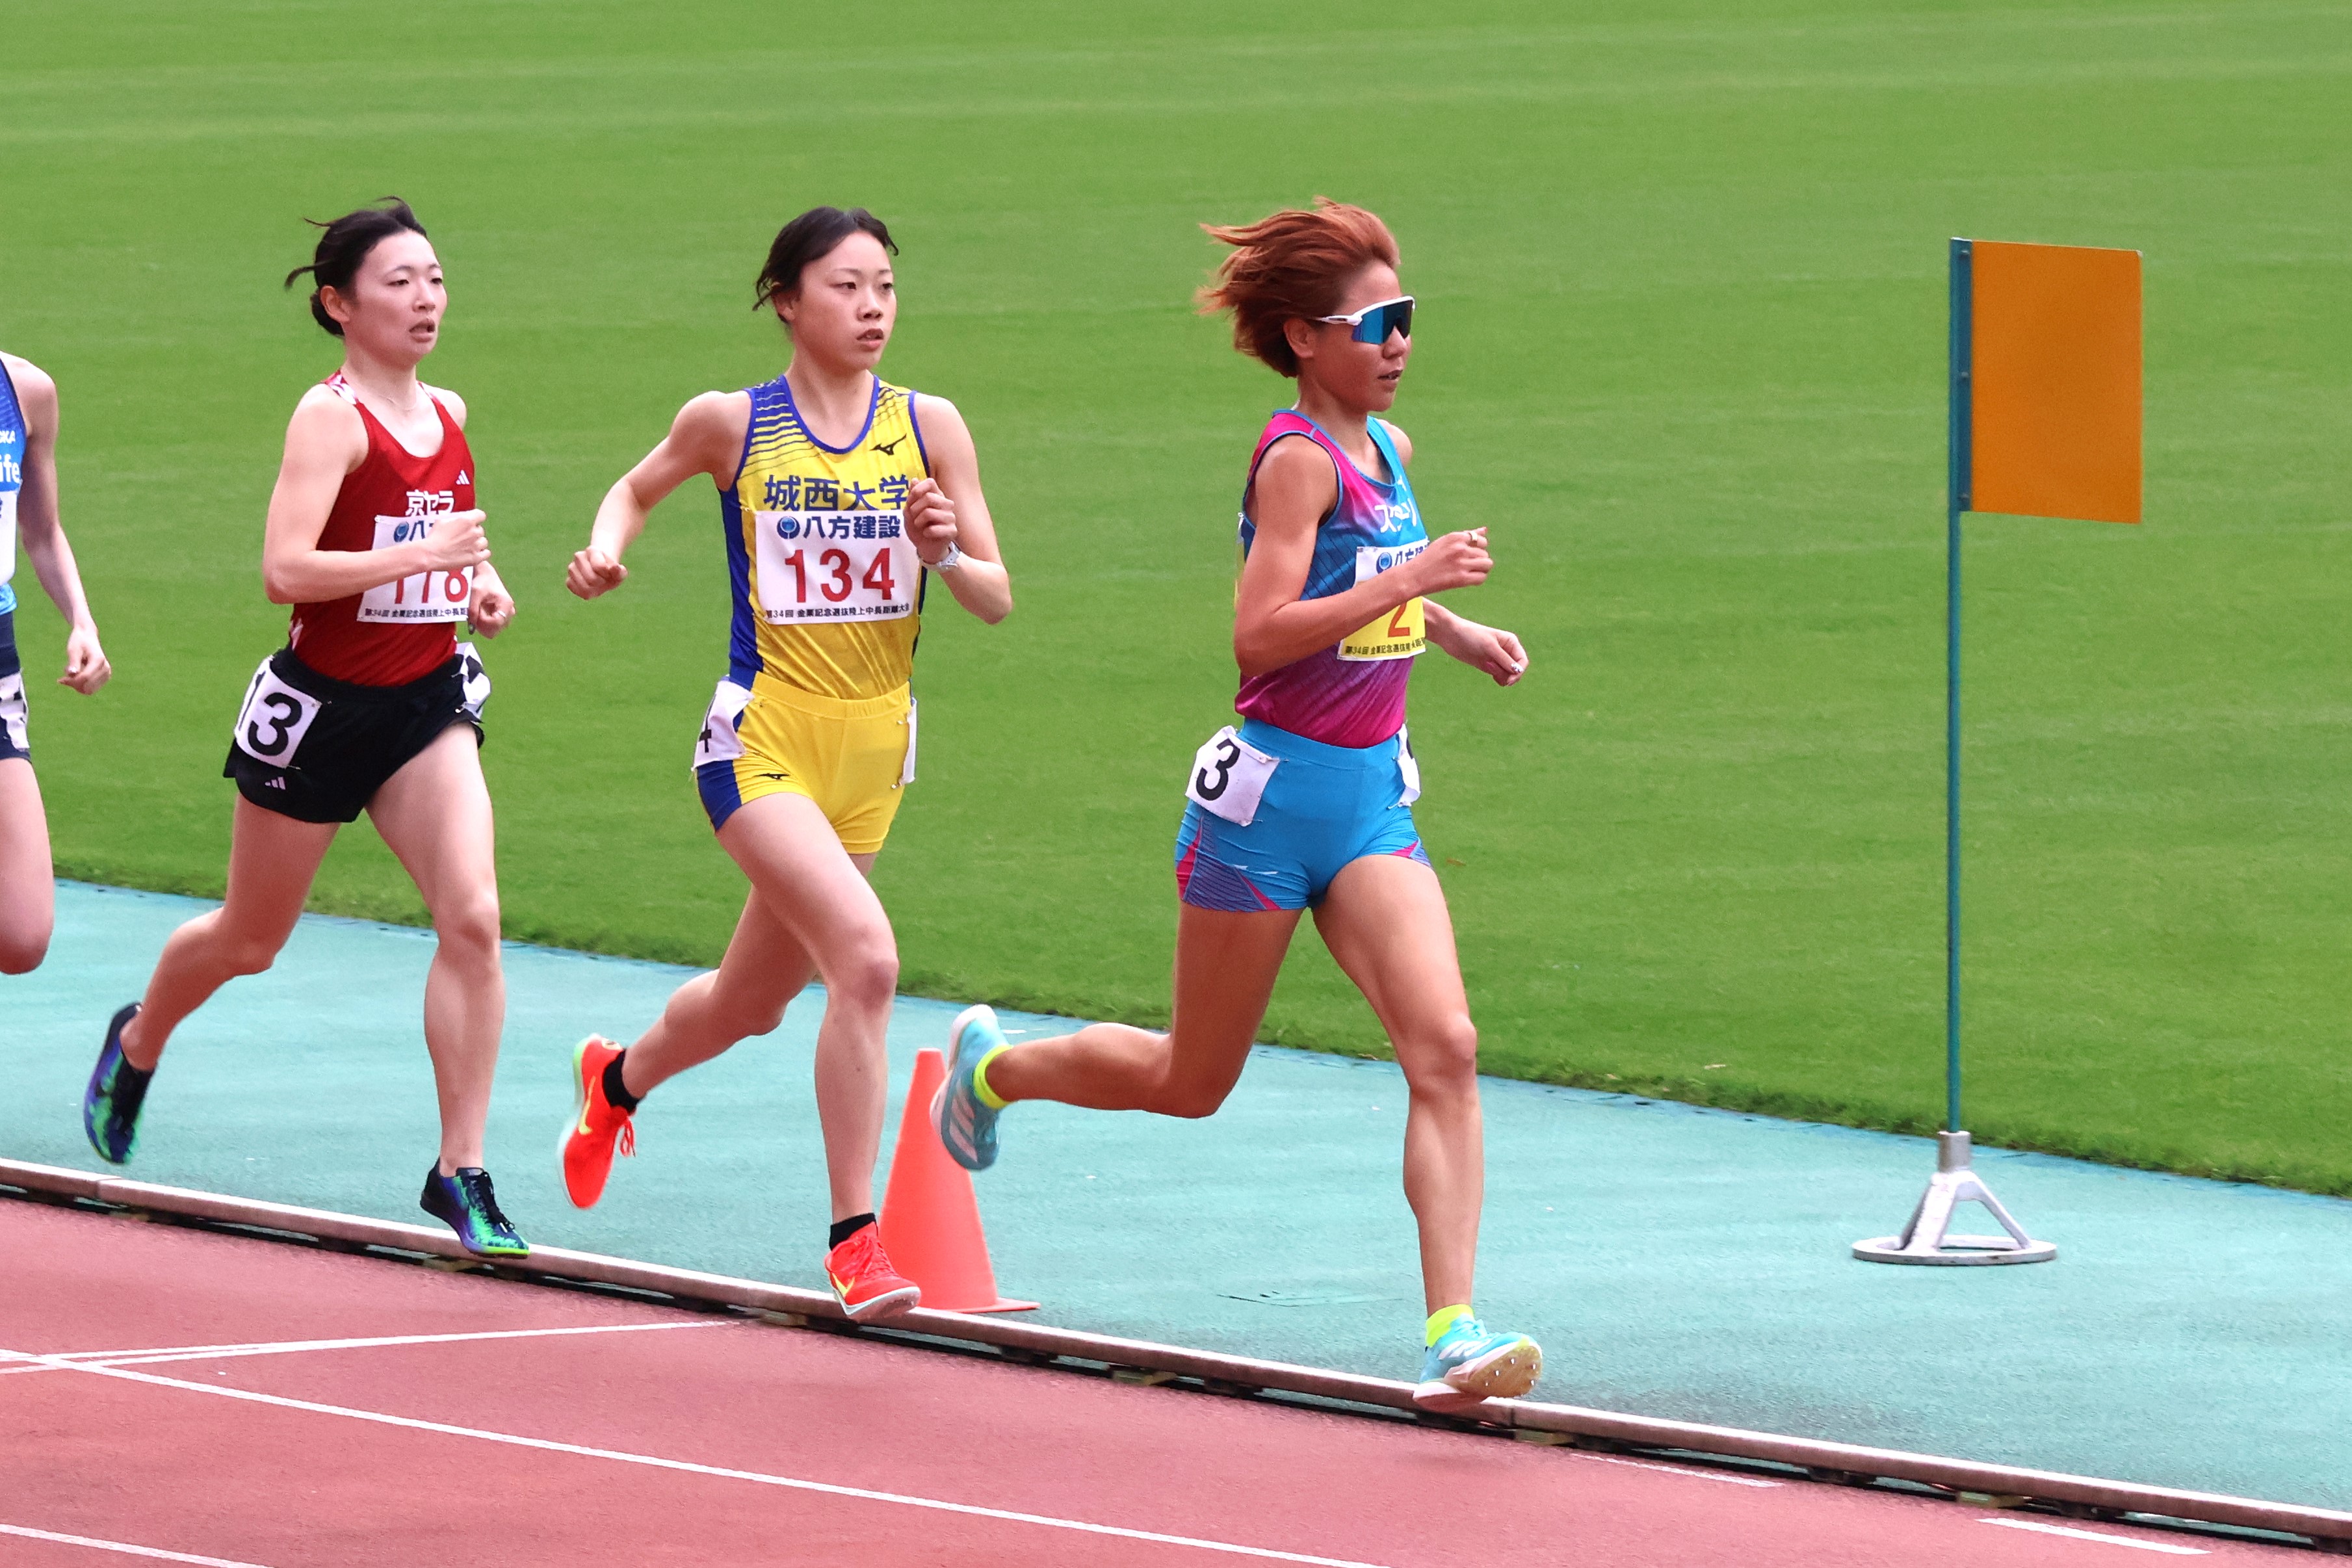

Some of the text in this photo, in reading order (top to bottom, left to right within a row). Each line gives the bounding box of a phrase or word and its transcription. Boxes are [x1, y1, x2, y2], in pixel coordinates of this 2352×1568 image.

[406, 490, 454, 516] 京セラ
[763, 473, 909, 511] 城西大学
[803, 516, 901, 540] 八方建設
[785, 548, 895, 603] 134
[1196, 738, 1241, 801] 3
